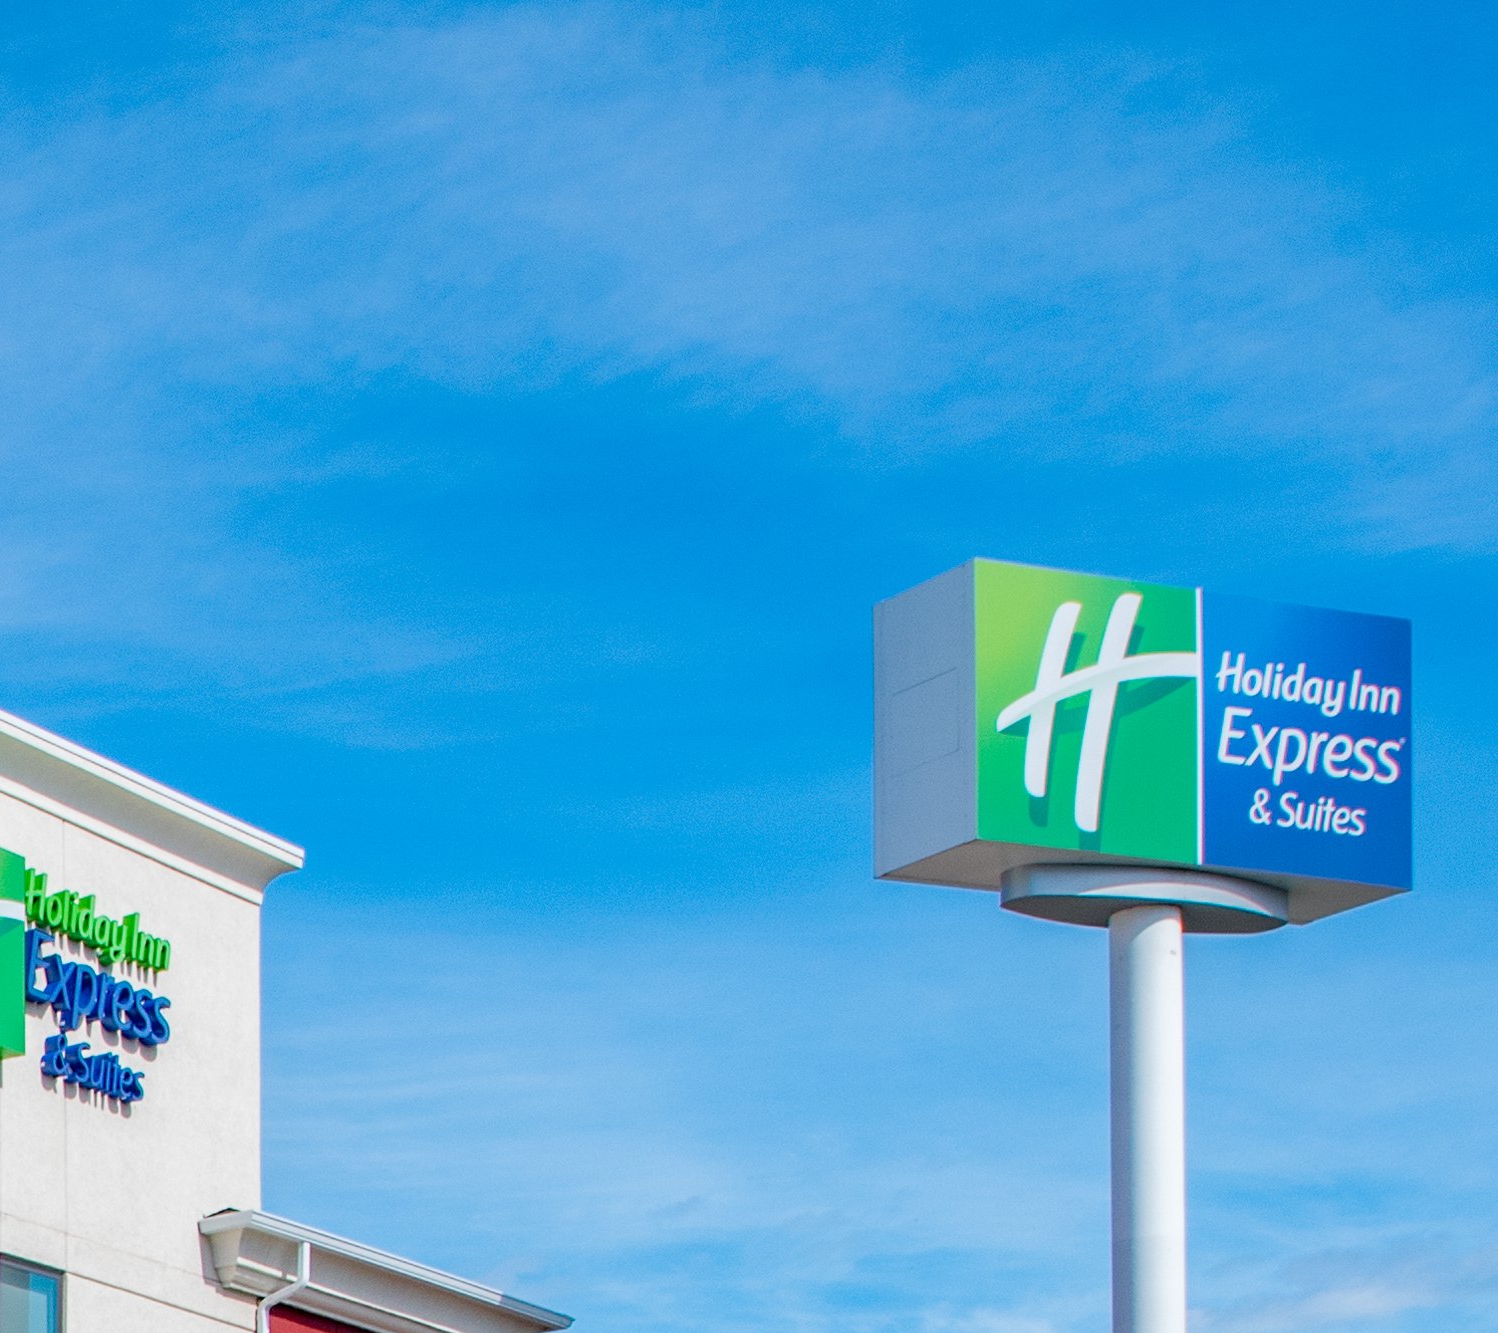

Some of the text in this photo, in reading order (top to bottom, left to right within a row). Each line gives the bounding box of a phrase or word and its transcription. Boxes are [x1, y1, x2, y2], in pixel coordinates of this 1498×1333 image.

[1215, 650, 1402, 718] Holiday Inn
[1218, 706, 1402, 786] Express
[1249, 788, 1368, 837] & Suites
[24, 867, 172, 974] Holiday Inn
[24, 928, 172, 1047] Express
[40, 1033, 145, 1104] & Suites
